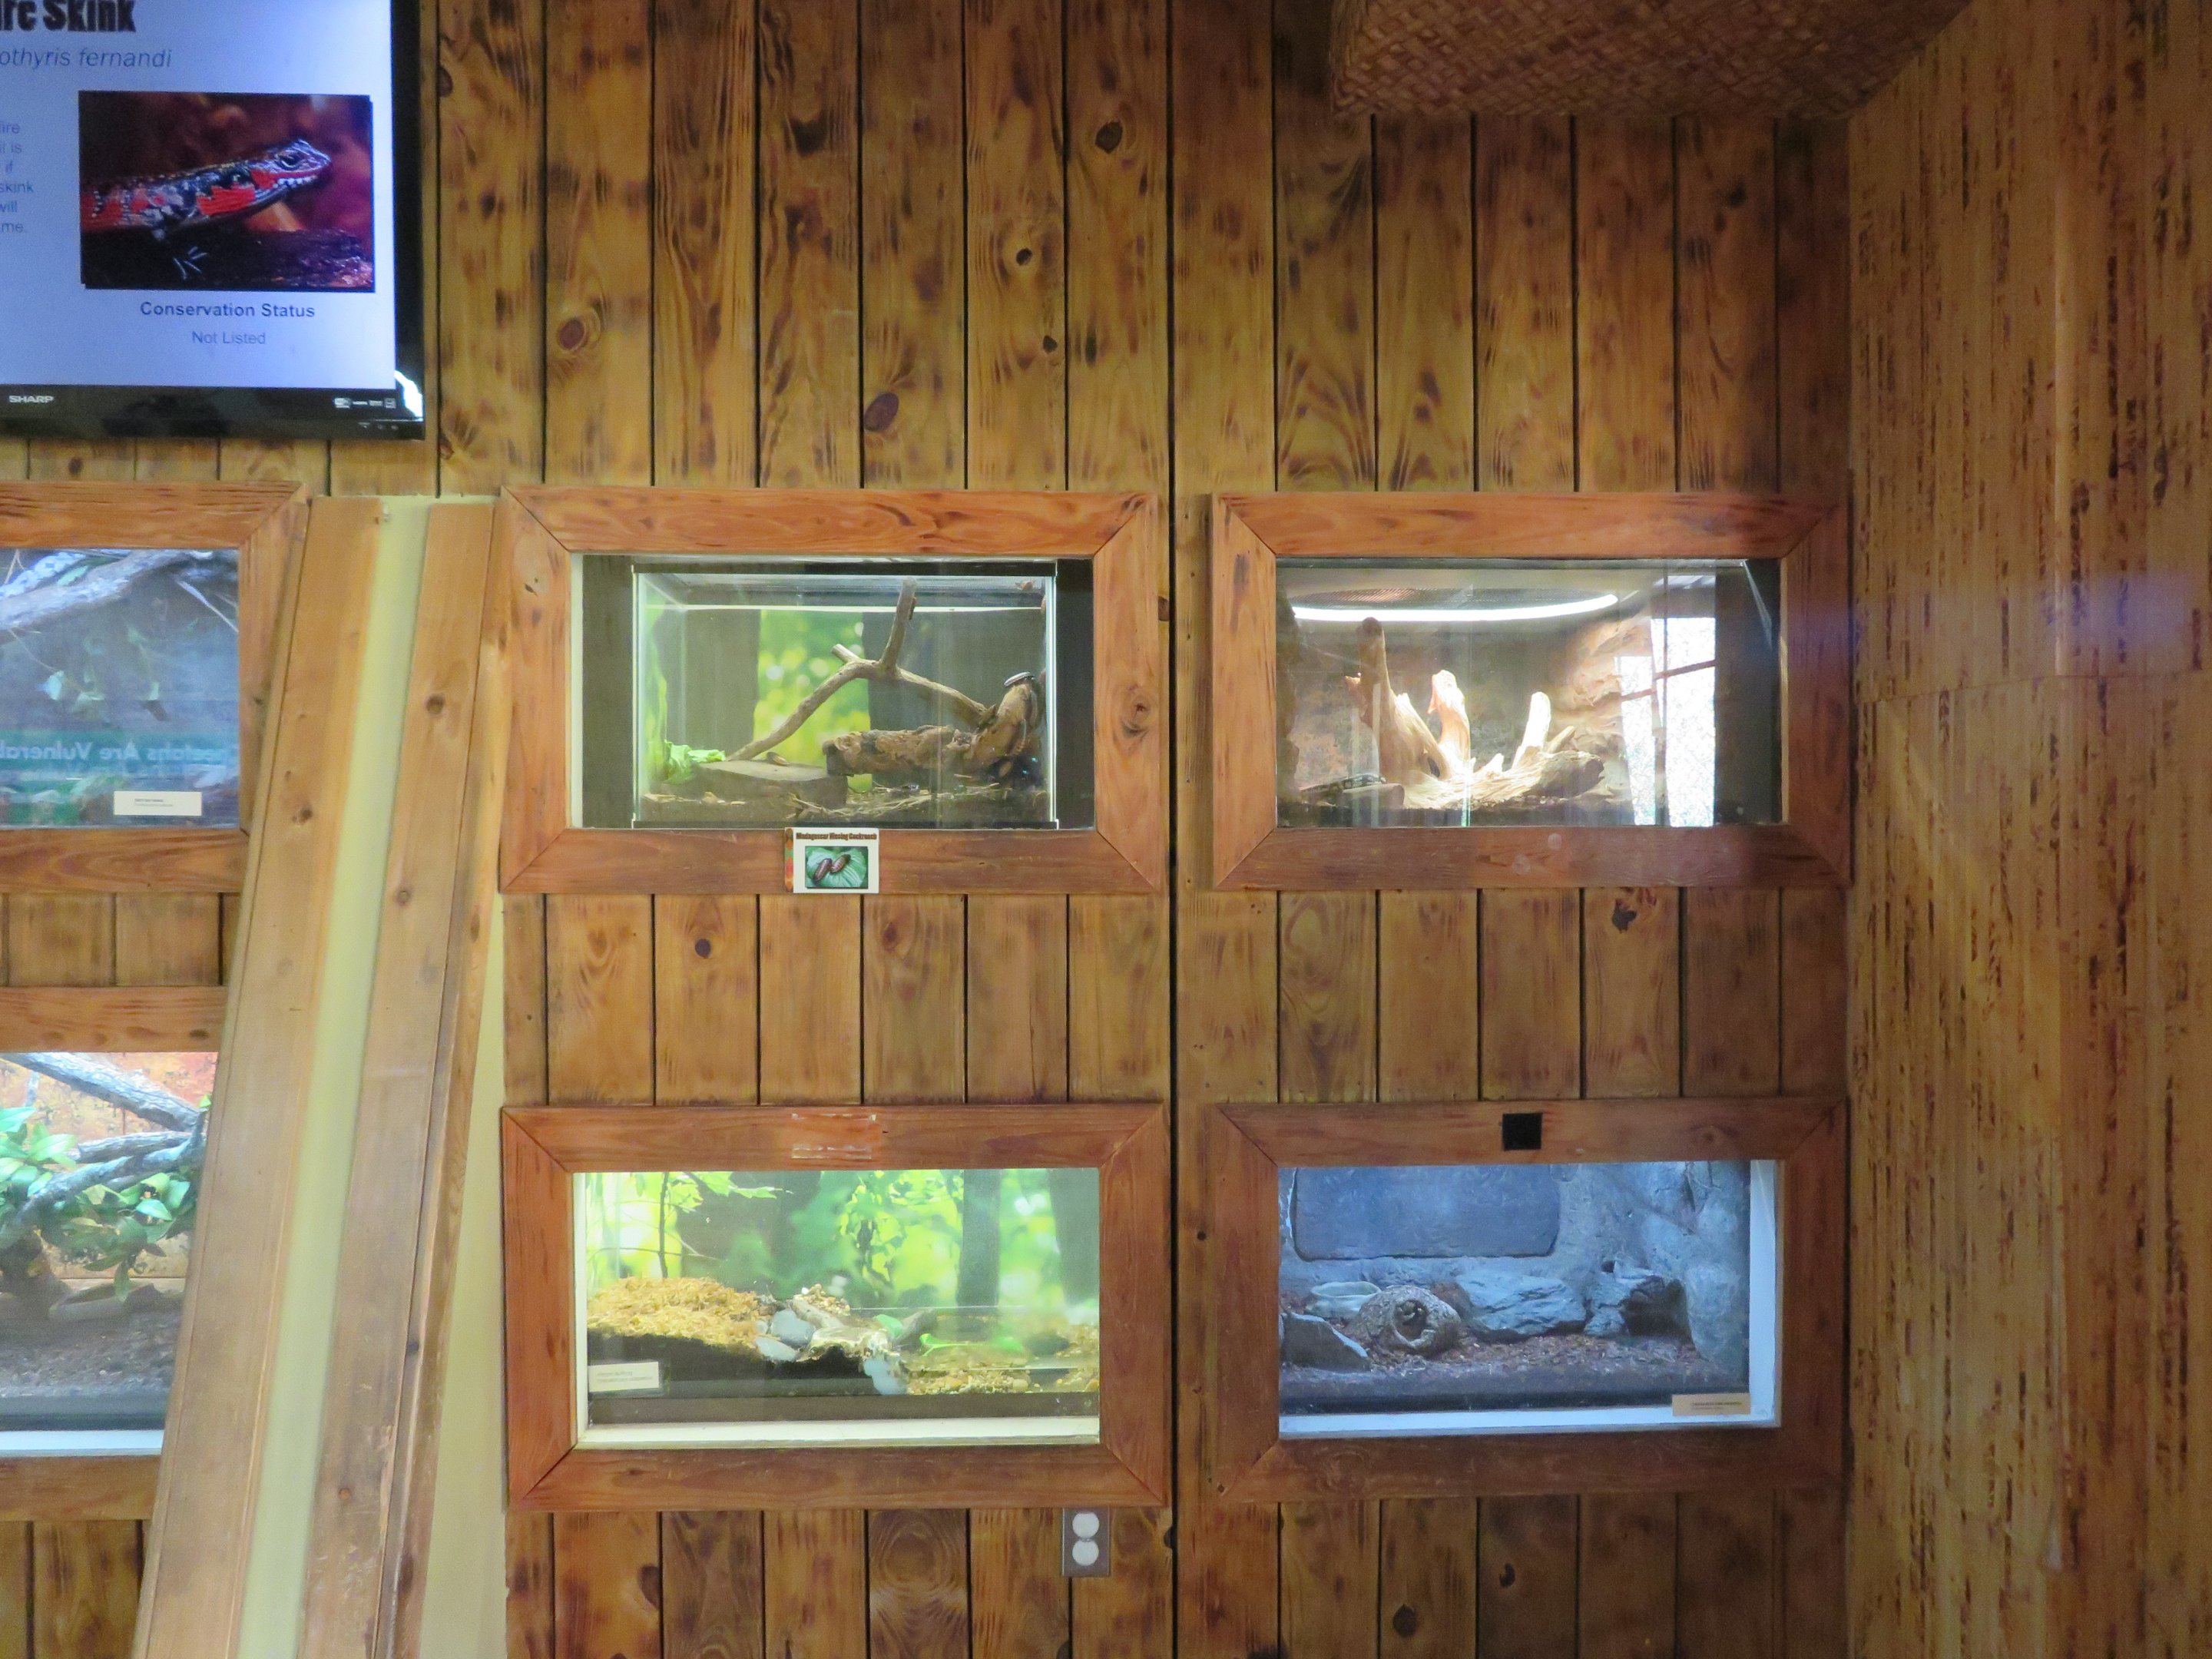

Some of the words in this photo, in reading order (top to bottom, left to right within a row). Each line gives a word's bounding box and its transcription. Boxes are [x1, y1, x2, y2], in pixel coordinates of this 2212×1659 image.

[0, 0, 36, 31] re
[43, 0, 137, 32] Skink
[0, 48, 71, 70] othyris
[80, 48, 172, 68] fernandi
[140, 302, 255, 316] Conservation
[261, 303, 315, 317] Status
[192, 331, 217, 344] Not
[222, 332, 266, 345] Listed
[8, 395, 55, 403] SHARP
